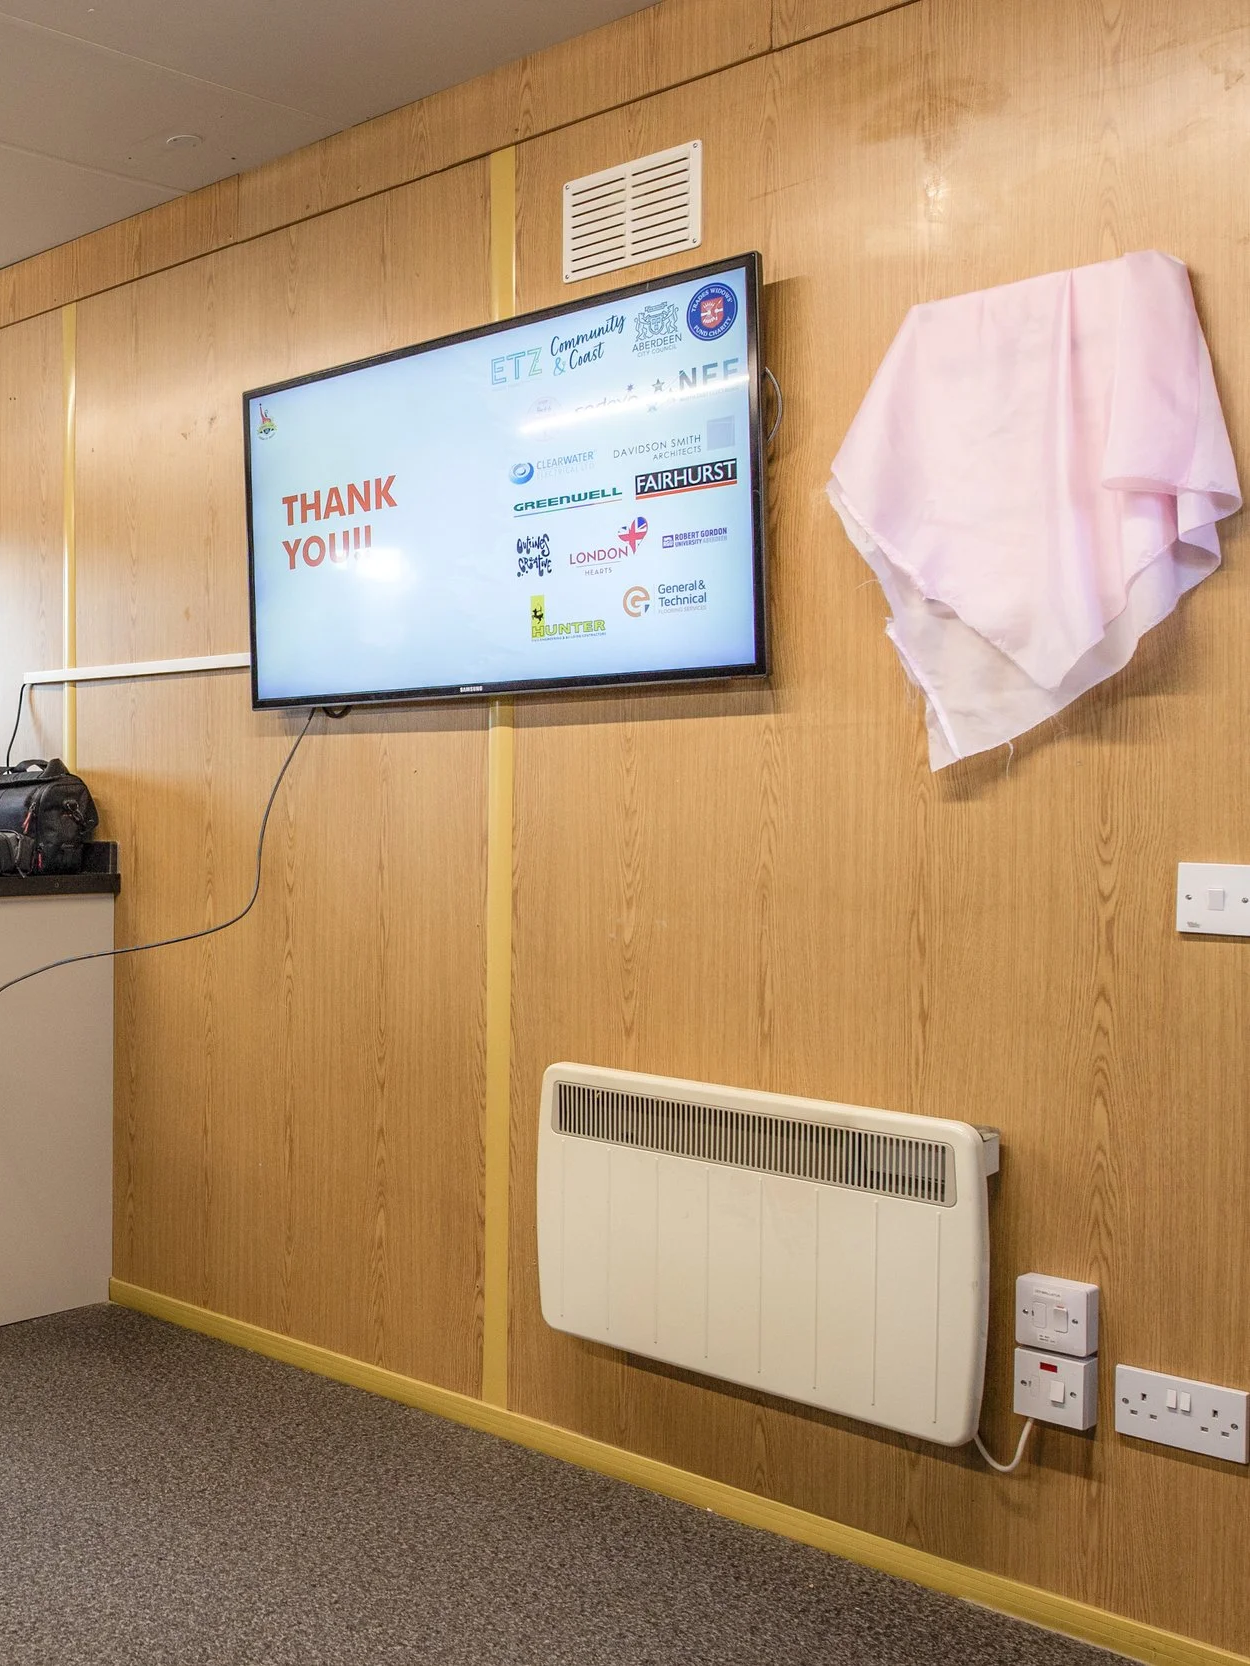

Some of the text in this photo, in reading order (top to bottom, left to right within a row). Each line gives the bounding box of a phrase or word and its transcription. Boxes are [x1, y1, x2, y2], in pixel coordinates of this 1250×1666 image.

[691, 289, 710, 312] TRADES
[550, 315, 626, 357] Community
[694, 317, 732, 337] FUND CHARITY
[632, 333, 682, 352] ABERDEEN
[491, 347, 543, 385] ETZ
[553, 342, 605, 376] & Coast
[613, 434, 701, 459] DAVIDSON SMITH
[653, 445, 702, 460] ARCHITECTS
[536, 451, 594, 470] CLEARWATER
[636, 460, 736, 493] FAIRHURST
[282, 475, 397, 526] THANK
[513, 487, 622, 511] GREENWELL
[675, 527, 728, 541] ROBERT GORDON
[675, 538, 702, 547] UNIVERSITY
[570, 546, 628, 565] LONDON
[585, 567, 613, 576] HEARTS
[658, 580, 706, 594] General &
[658, 592, 707, 607] Technical
[531, 620, 606, 638] HUNTER
